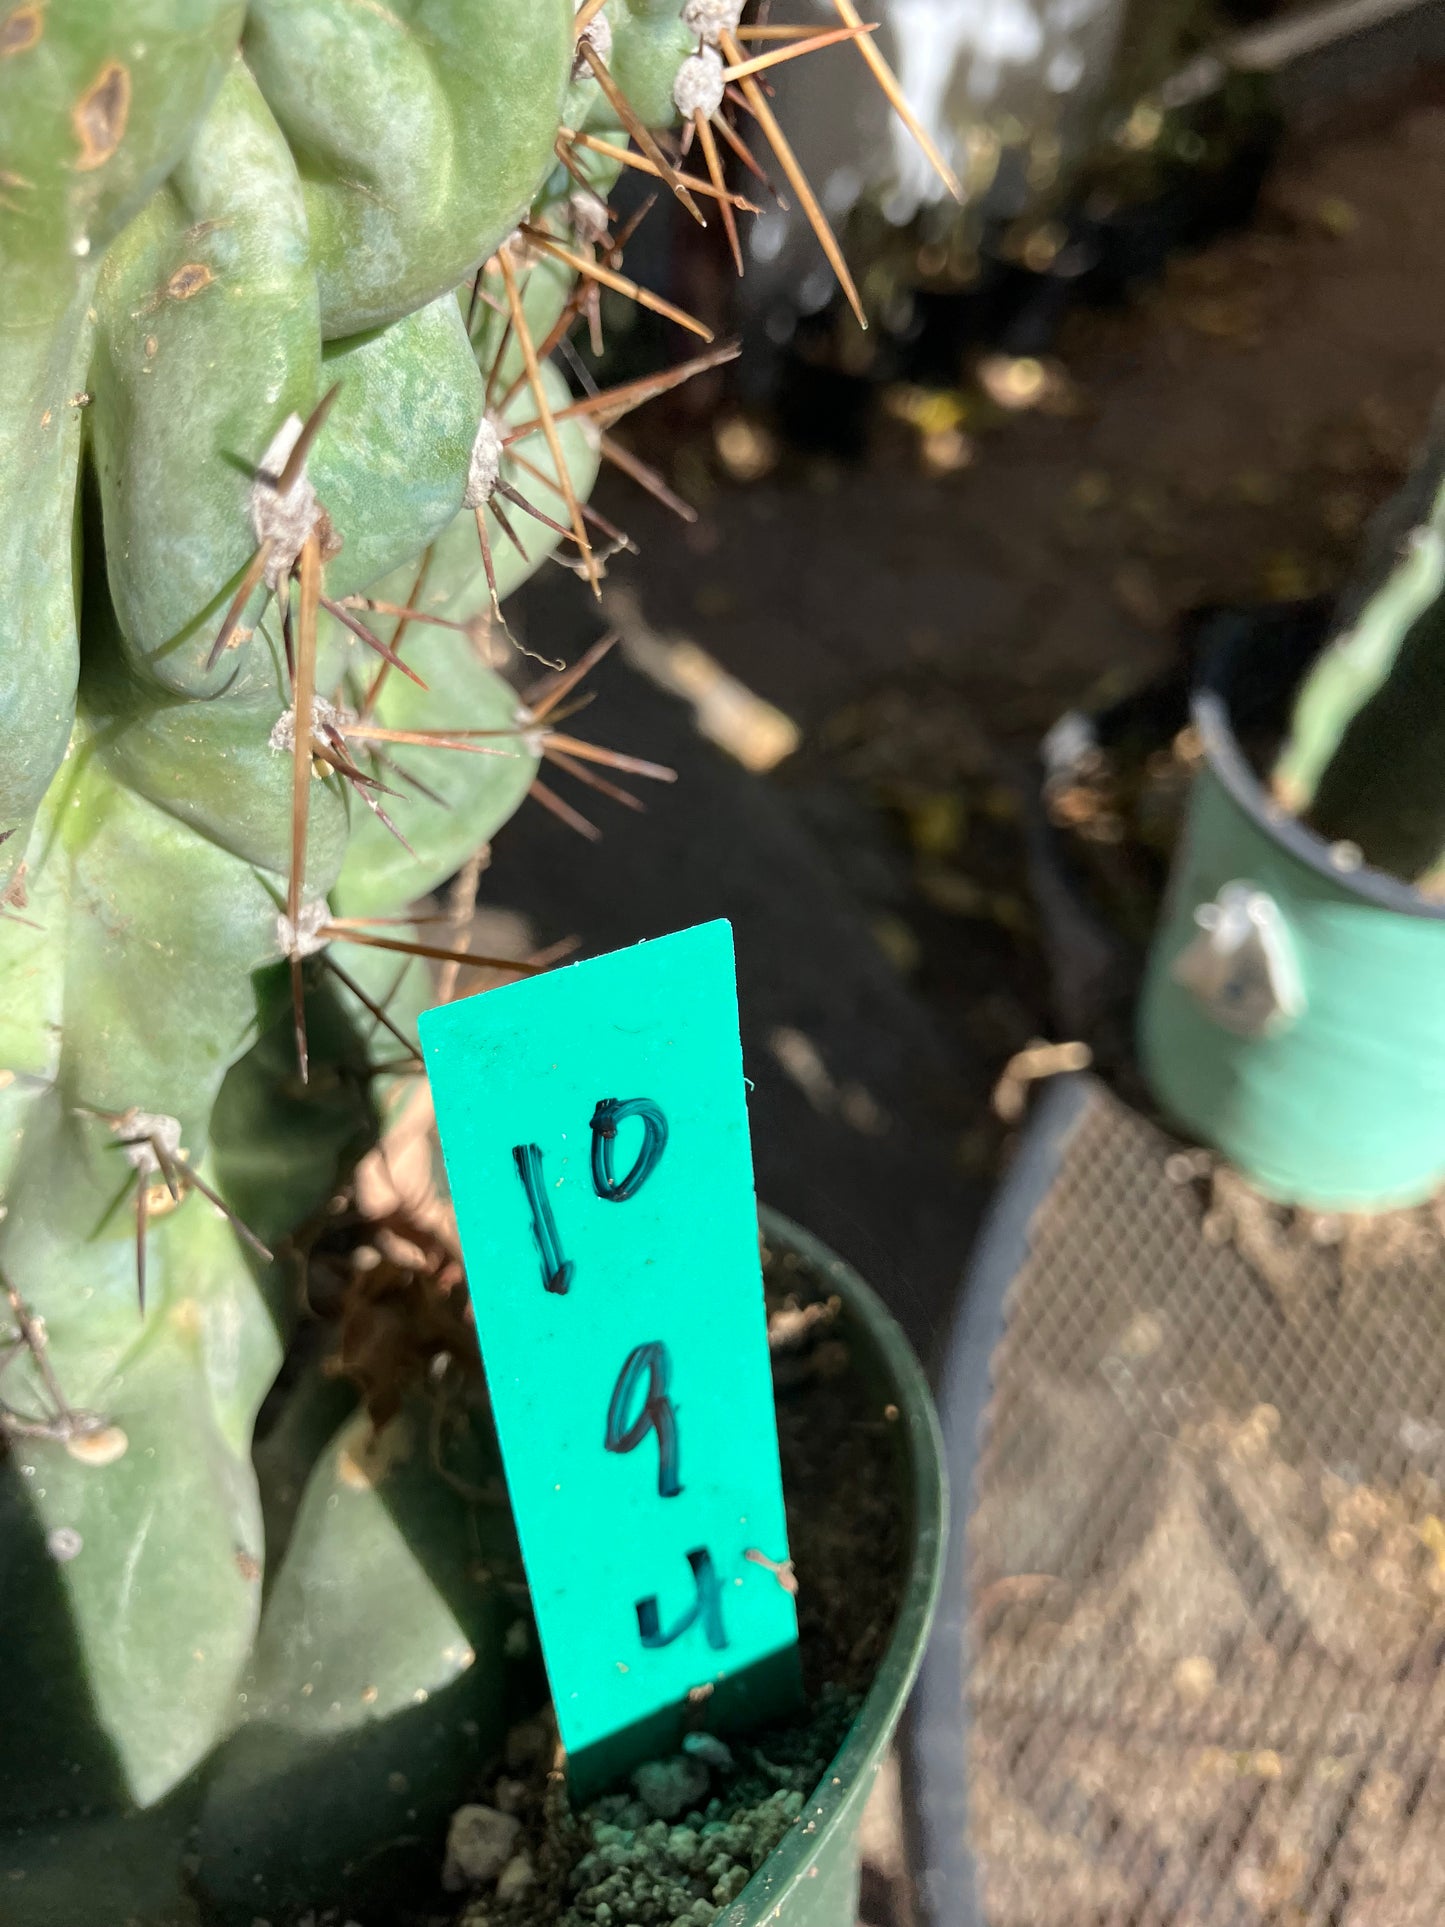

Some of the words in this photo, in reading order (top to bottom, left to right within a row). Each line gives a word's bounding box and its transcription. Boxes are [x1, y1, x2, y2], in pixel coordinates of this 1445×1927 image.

[511, 1097, 669, 1296] 10
[604, 1340, 684, 1498] 9
[635, 1544, 729, 1650] 4
